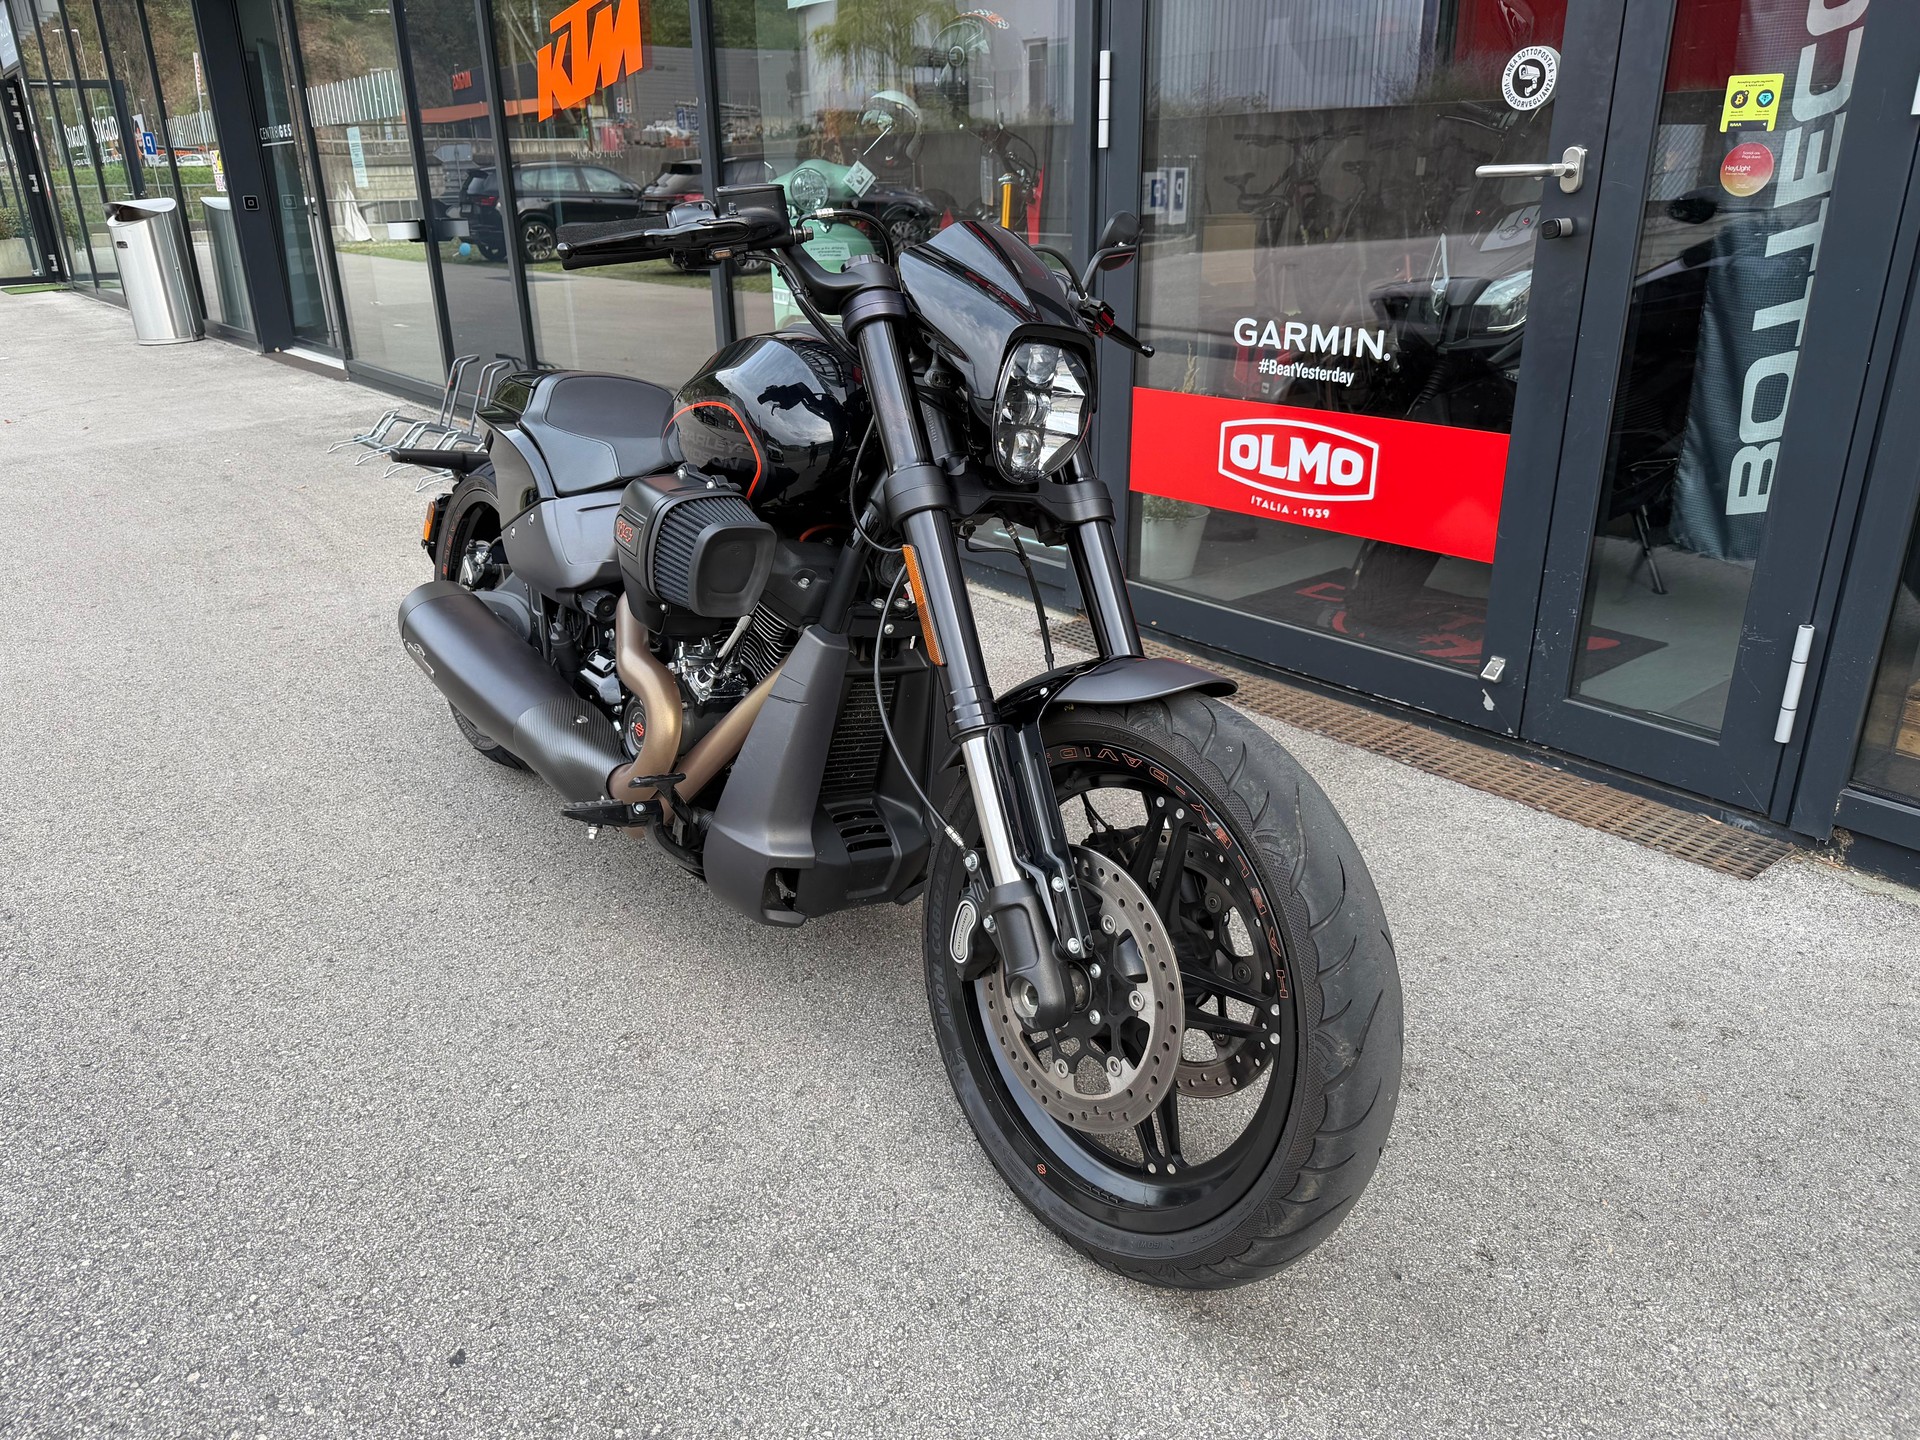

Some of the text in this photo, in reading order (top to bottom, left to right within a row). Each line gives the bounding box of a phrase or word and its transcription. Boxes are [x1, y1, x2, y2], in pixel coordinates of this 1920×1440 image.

[537, 0, 644, 123] KTM
[1505, 59, 1519, 78] AREA
[1518, 48, 1553, 68] SOTTOPOSTA
[1503, 78, 1555, 108] VIDEOSORVEGLIANZA
[1724, 164, 1752, 173] HeyLight
[1257, 357, 1355, 388] #BeatYesterday
[1229, 433, 1365, 487] OLMO
[1250, 495, 1331, 519] ITALIA 1939
[930, 873, 948, 956] COBRA
[931, 961, 955, 1033] AVON
